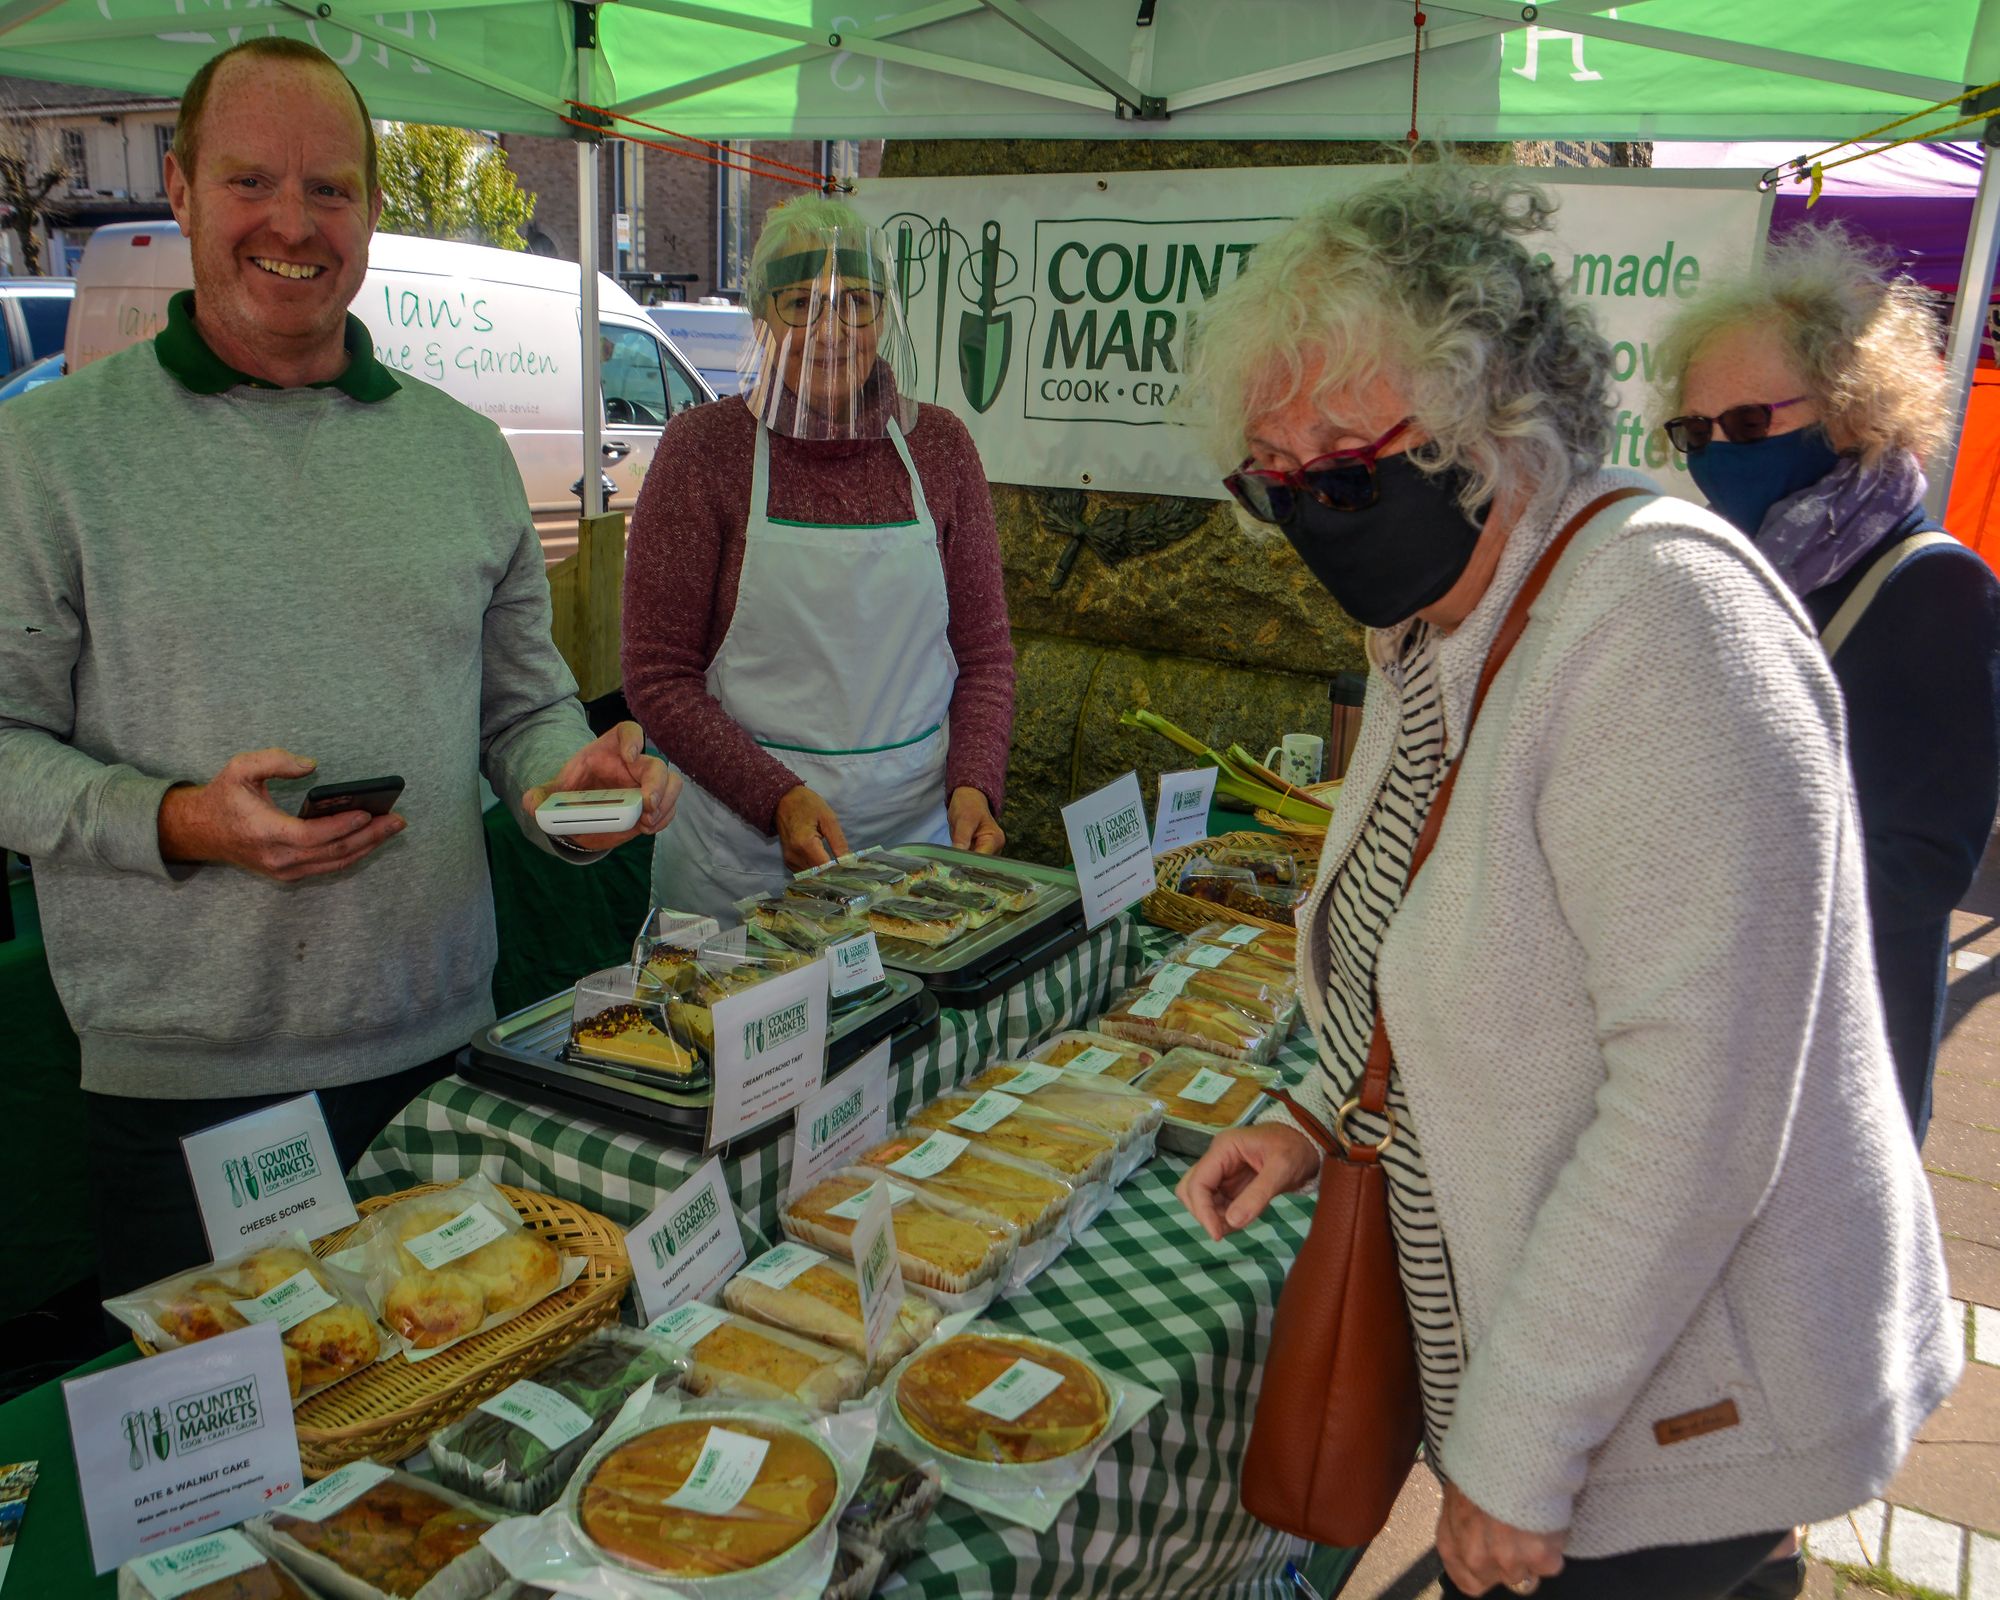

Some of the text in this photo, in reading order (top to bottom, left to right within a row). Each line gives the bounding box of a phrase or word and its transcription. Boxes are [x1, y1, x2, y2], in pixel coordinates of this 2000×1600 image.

[1048, 241, 1258, 304] COUNT
[1570, 241, 1700, 299] made
[385, 285, 493, 332] Ian's
[375, 345, 413, 370] me
[455, 342, 559, 380] Garden
[1041, 379, 1110, 403] COOK
[1105, 805, 1137, 833] COUNTRY
[1107, 818, 1140, 845] MARKETS
[768, 1001, 807, 1029] COUNTRY
[768, 1013, 806, 1041] MARKETS
[742, 1052, 804, 1089] CREAMY PISTACHIO TART
[831, 1090, 862, 1119] COUNTRY
[831, 1101, 862, 1130] MARKETS
[257, 1138, 308, 1169] COUNTRY
[262, 1153, 314, 1185] MARKETS
[239, 1197, 317, 1236] CHEESE SCONES
[673, 1188, 713, 1229] COUNTRY
[677, 1200, 716, 1241] MARKETS
[662, 1229, 722, 1289] TRADITIONAL SEED CAKE
[175, 1383, 253, 1422] COUNTRY
[179, 1400, 257, 1441] MARKETS
[181, 1419, 258, 1450] COOK CRAFT GROW
[134, 1458, 251, 1507] DATE & WALNUT CAKE
